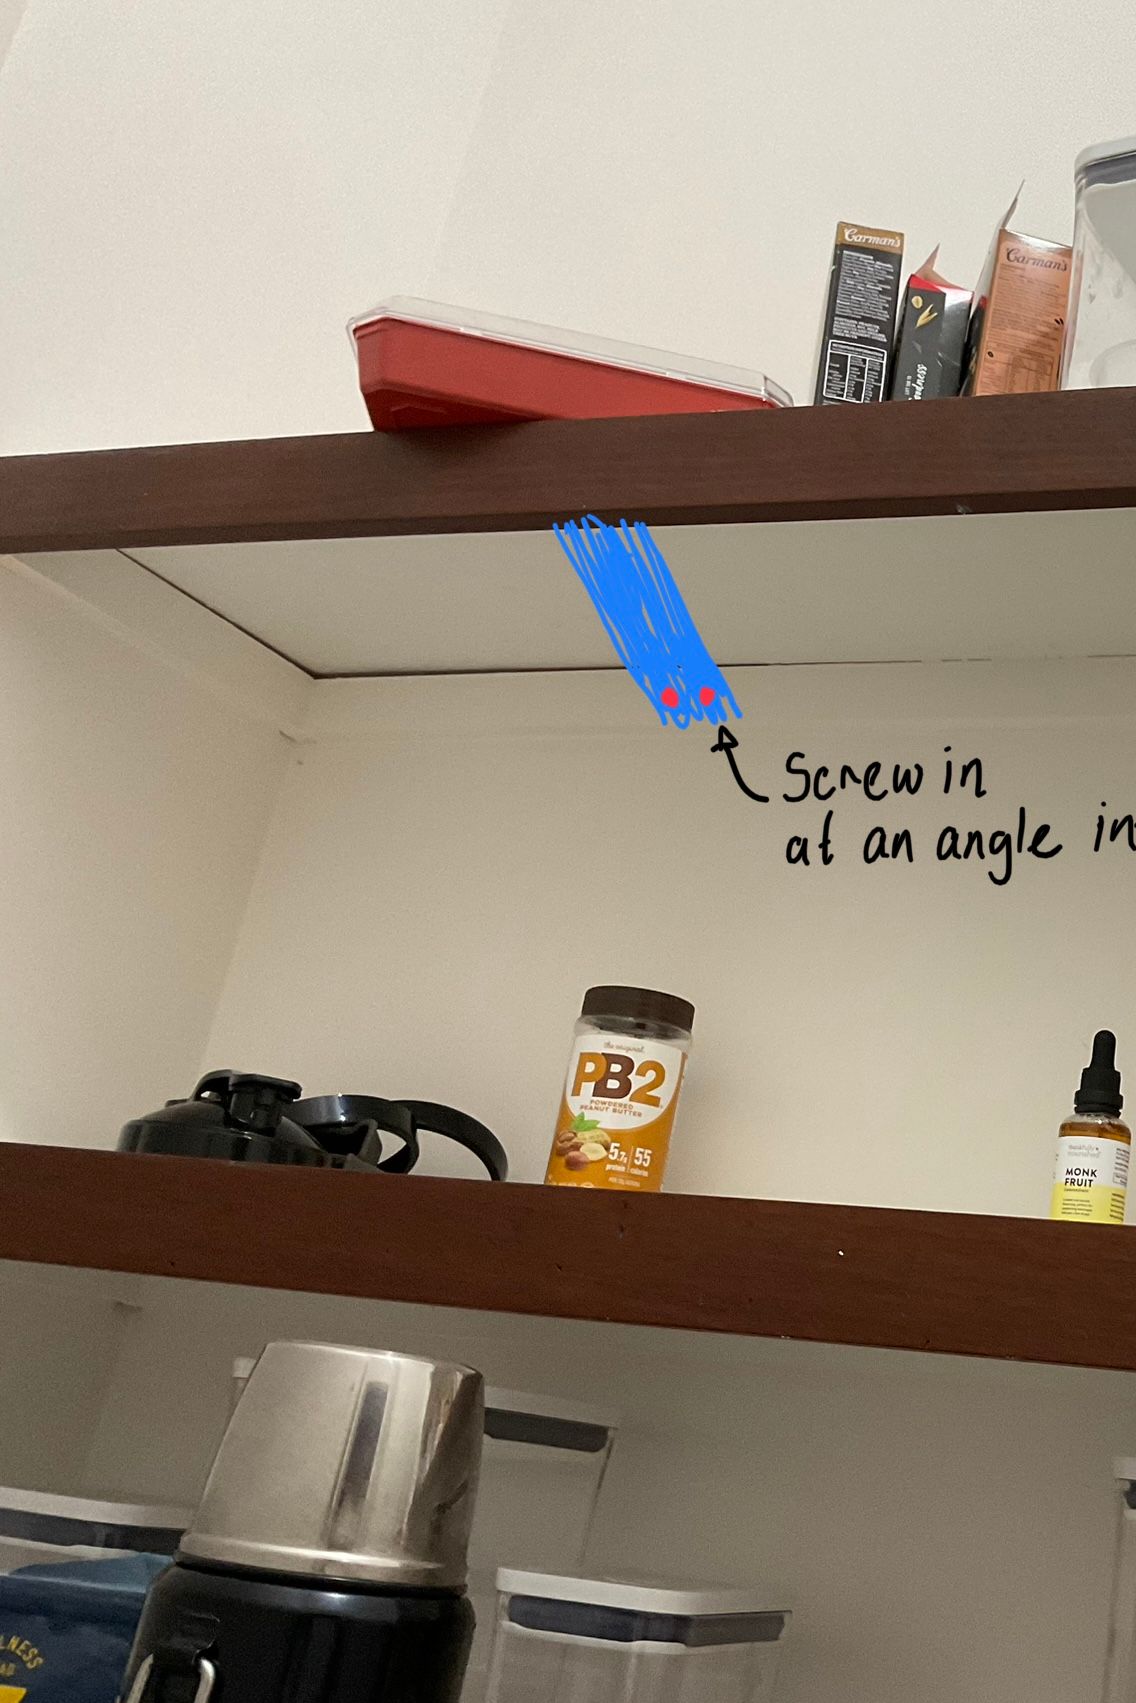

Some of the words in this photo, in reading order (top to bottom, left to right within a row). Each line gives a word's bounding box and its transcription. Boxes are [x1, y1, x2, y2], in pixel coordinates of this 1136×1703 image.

[844, 227, 901, 248] Carman's
[1005, 247, 1068, 272] Carman's
[571, 1052, 666, 1109] PB2
[580, 1104, 610, 1112] PEANUT
[612, 1107, 643, 1118] BUTTER
[590, 1099, 634, 1110] POWDERED
[634, 1146, 653, 1168] 55
[1065, 1167, 1098, 1178] MONK
[1064, 1177, 1094, 1188] FRUIT
